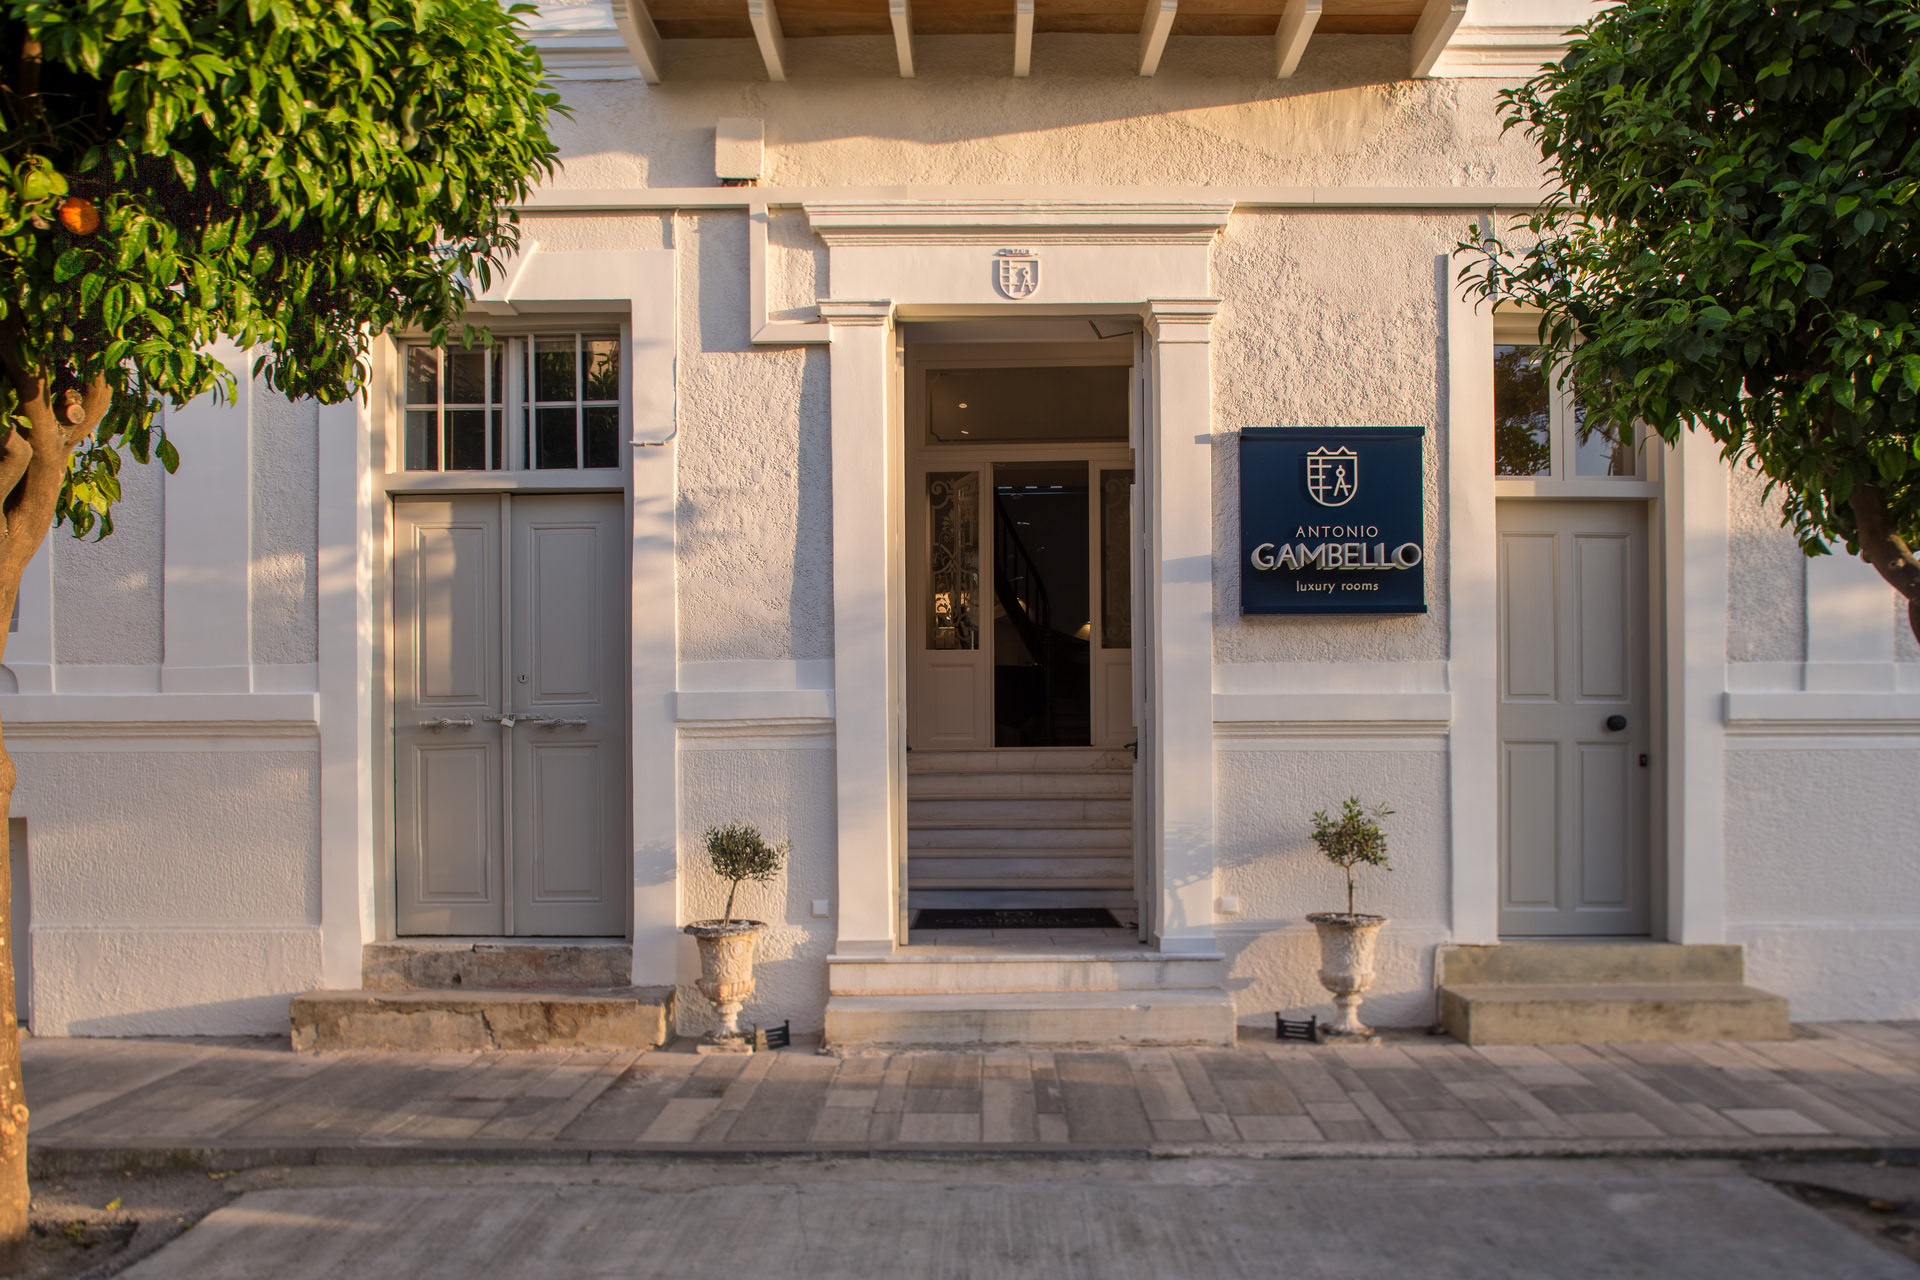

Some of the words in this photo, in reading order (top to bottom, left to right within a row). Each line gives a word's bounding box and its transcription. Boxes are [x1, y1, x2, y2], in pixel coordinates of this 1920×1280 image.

[1296, 525, 1379, 538] ANTONIO
[1251, 542, 1422, 570] GAMBELLO
[1296, 580, 1335, 594] luxury
[1341, 582, 1379, 592] rooms
